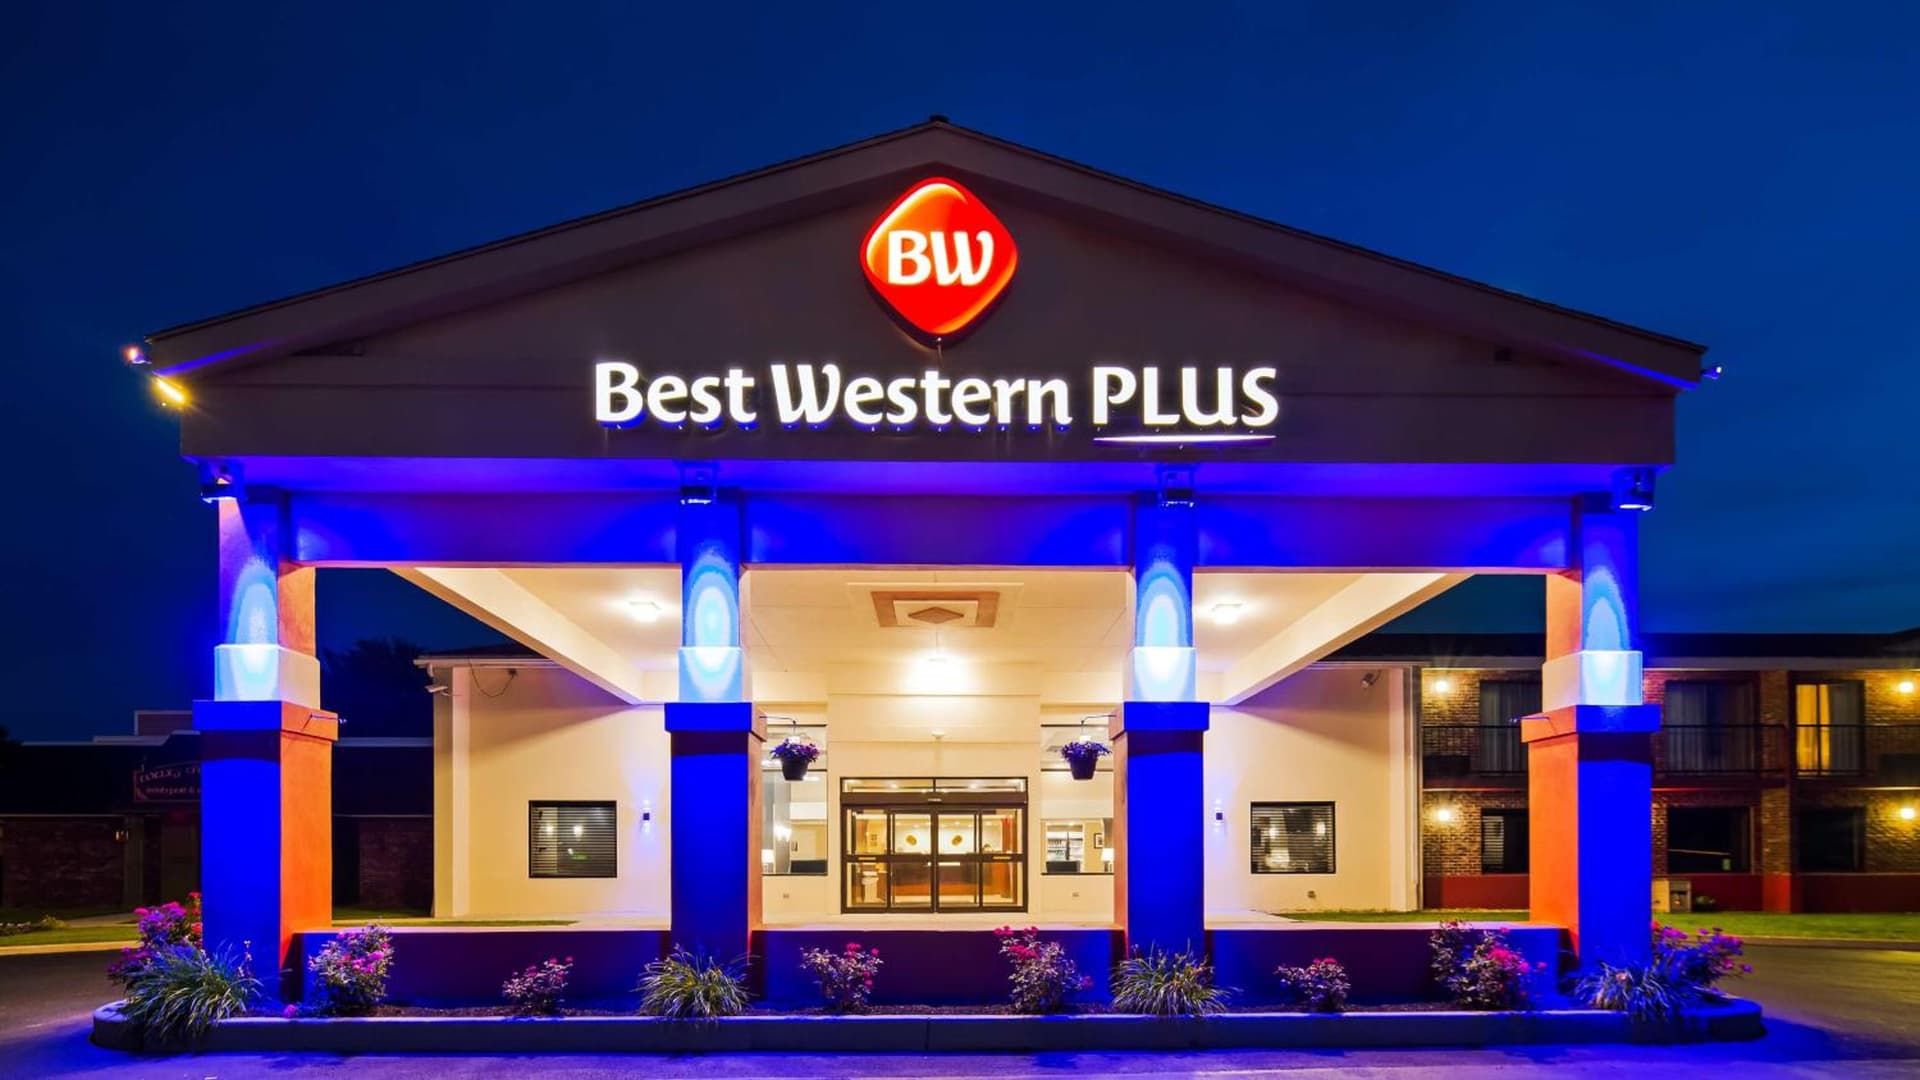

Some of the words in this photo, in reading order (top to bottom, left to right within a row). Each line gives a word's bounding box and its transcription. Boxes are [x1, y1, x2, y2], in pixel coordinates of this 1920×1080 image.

[887, 230, 994, 286] BW
[594, 361, 756, 424] Best
[770, 363, 1073, 425] Western
[1092, 366, 1280, 427] PLUS
